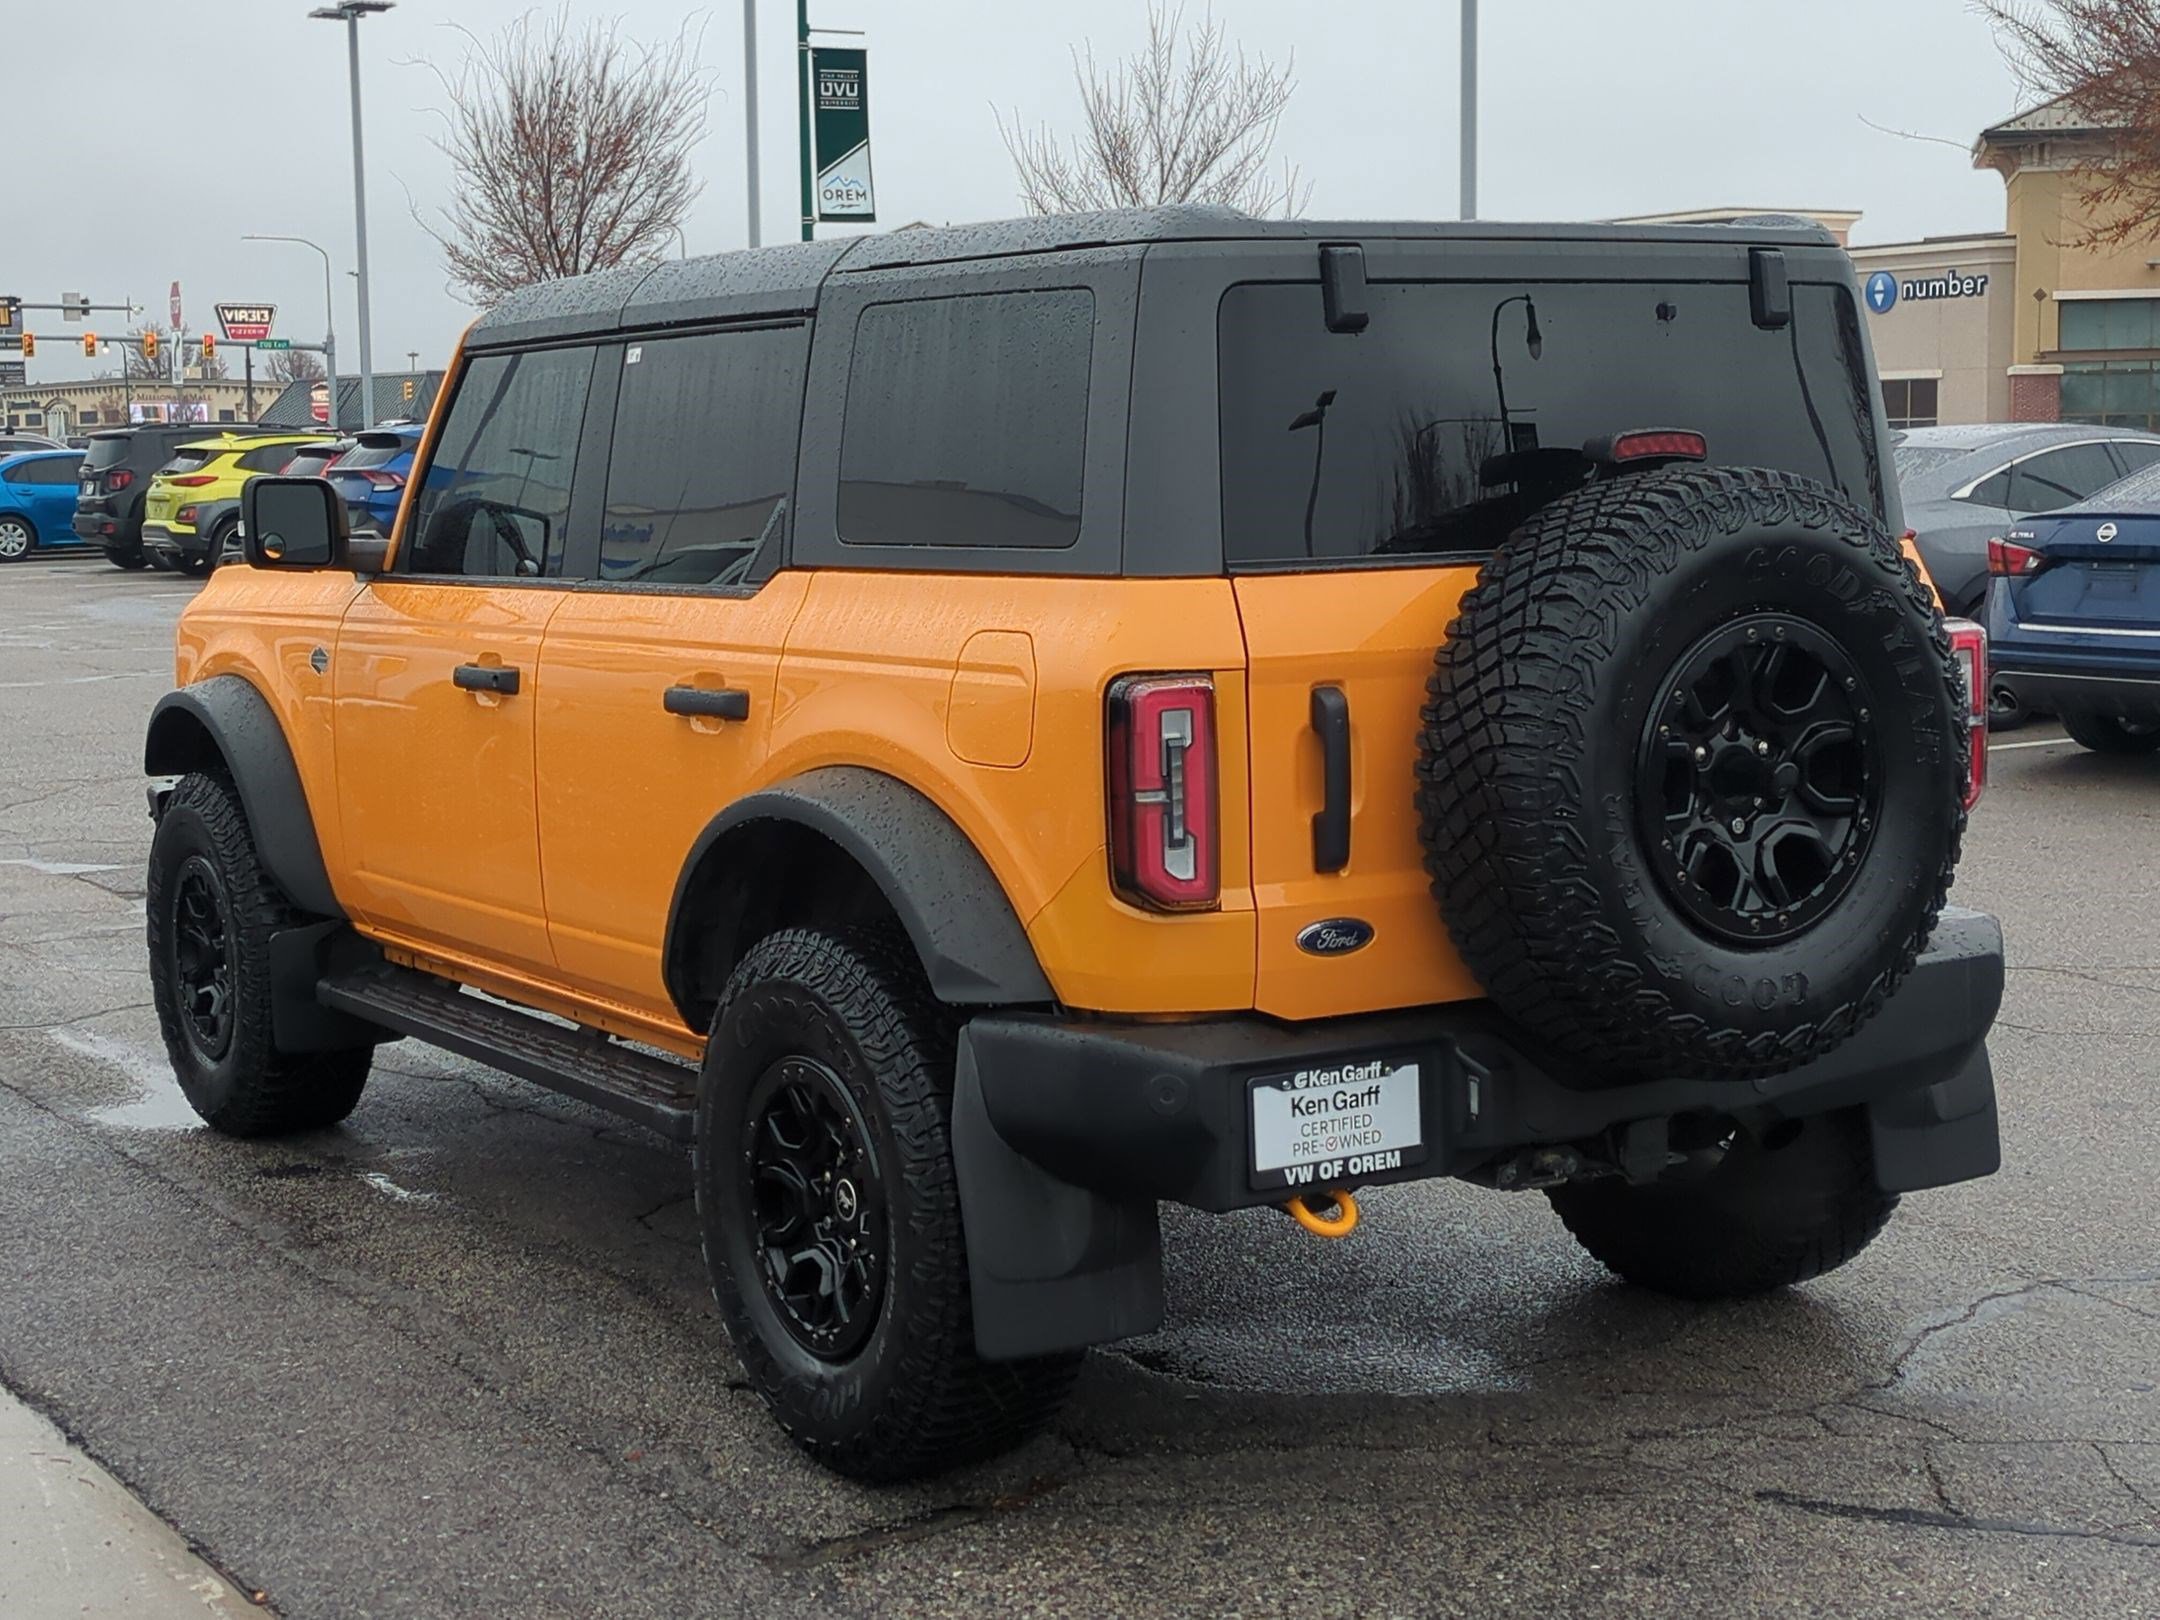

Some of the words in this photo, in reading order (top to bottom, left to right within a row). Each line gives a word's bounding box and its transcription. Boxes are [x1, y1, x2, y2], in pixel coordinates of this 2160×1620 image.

[820, 82, 858, 97] UVU
[823, 189, 867, 200] OREM
[1902, 270, 1987, 300] number
[1317, 928, 1359, 950] Ford
[1309, 1069, 1340, 1087] Ken
[1342, 1061, 1382, 1083] Garff
[1291, 1095, 1329, 1118] Ken
[1333, 1085, 1381, 1111] Garff
[1301, 1113, 1373, 1138] CERTIFIED
[1284, 1164, 1314, 1186] VW
[1319, 1159, 1343, 1181] OF
[1348, 1150, 1401, 1176] OREM
